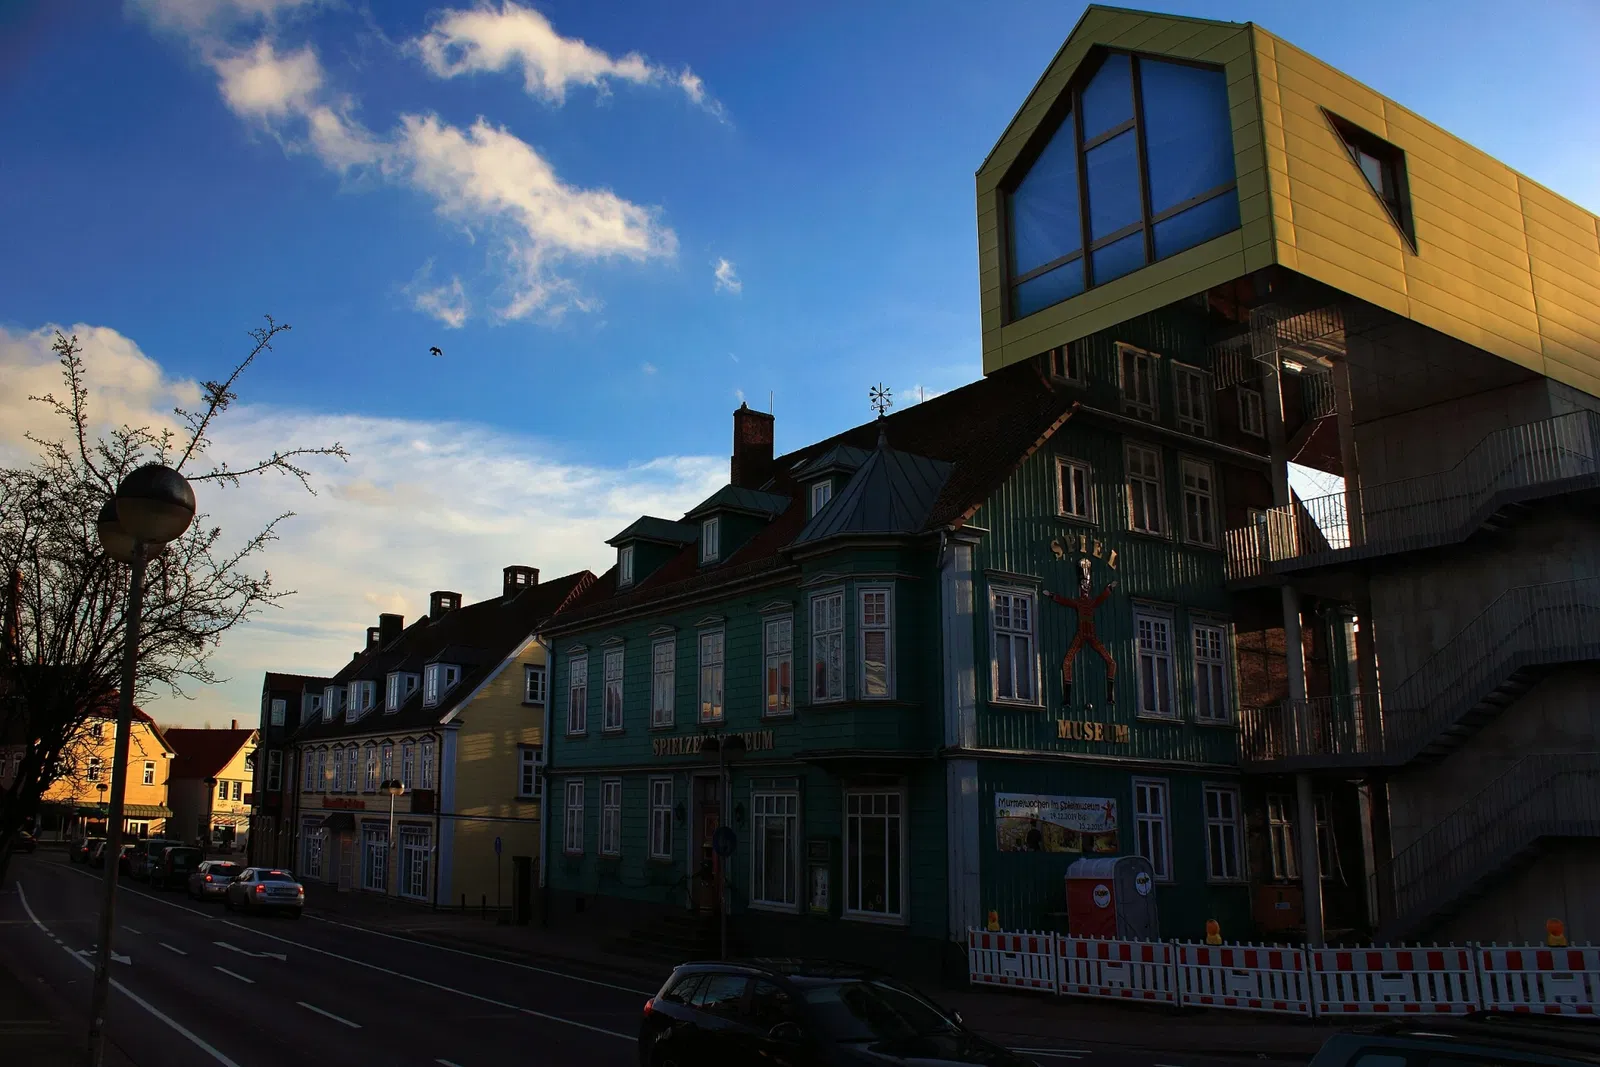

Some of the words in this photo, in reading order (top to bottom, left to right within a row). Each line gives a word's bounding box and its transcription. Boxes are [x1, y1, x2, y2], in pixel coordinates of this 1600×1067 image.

[1050, 533, 1119, 570] SPIEL
[652, 729, 775, 757] SPIELZEEUM
[1057, 718, 1129, 745] MUSEUM
